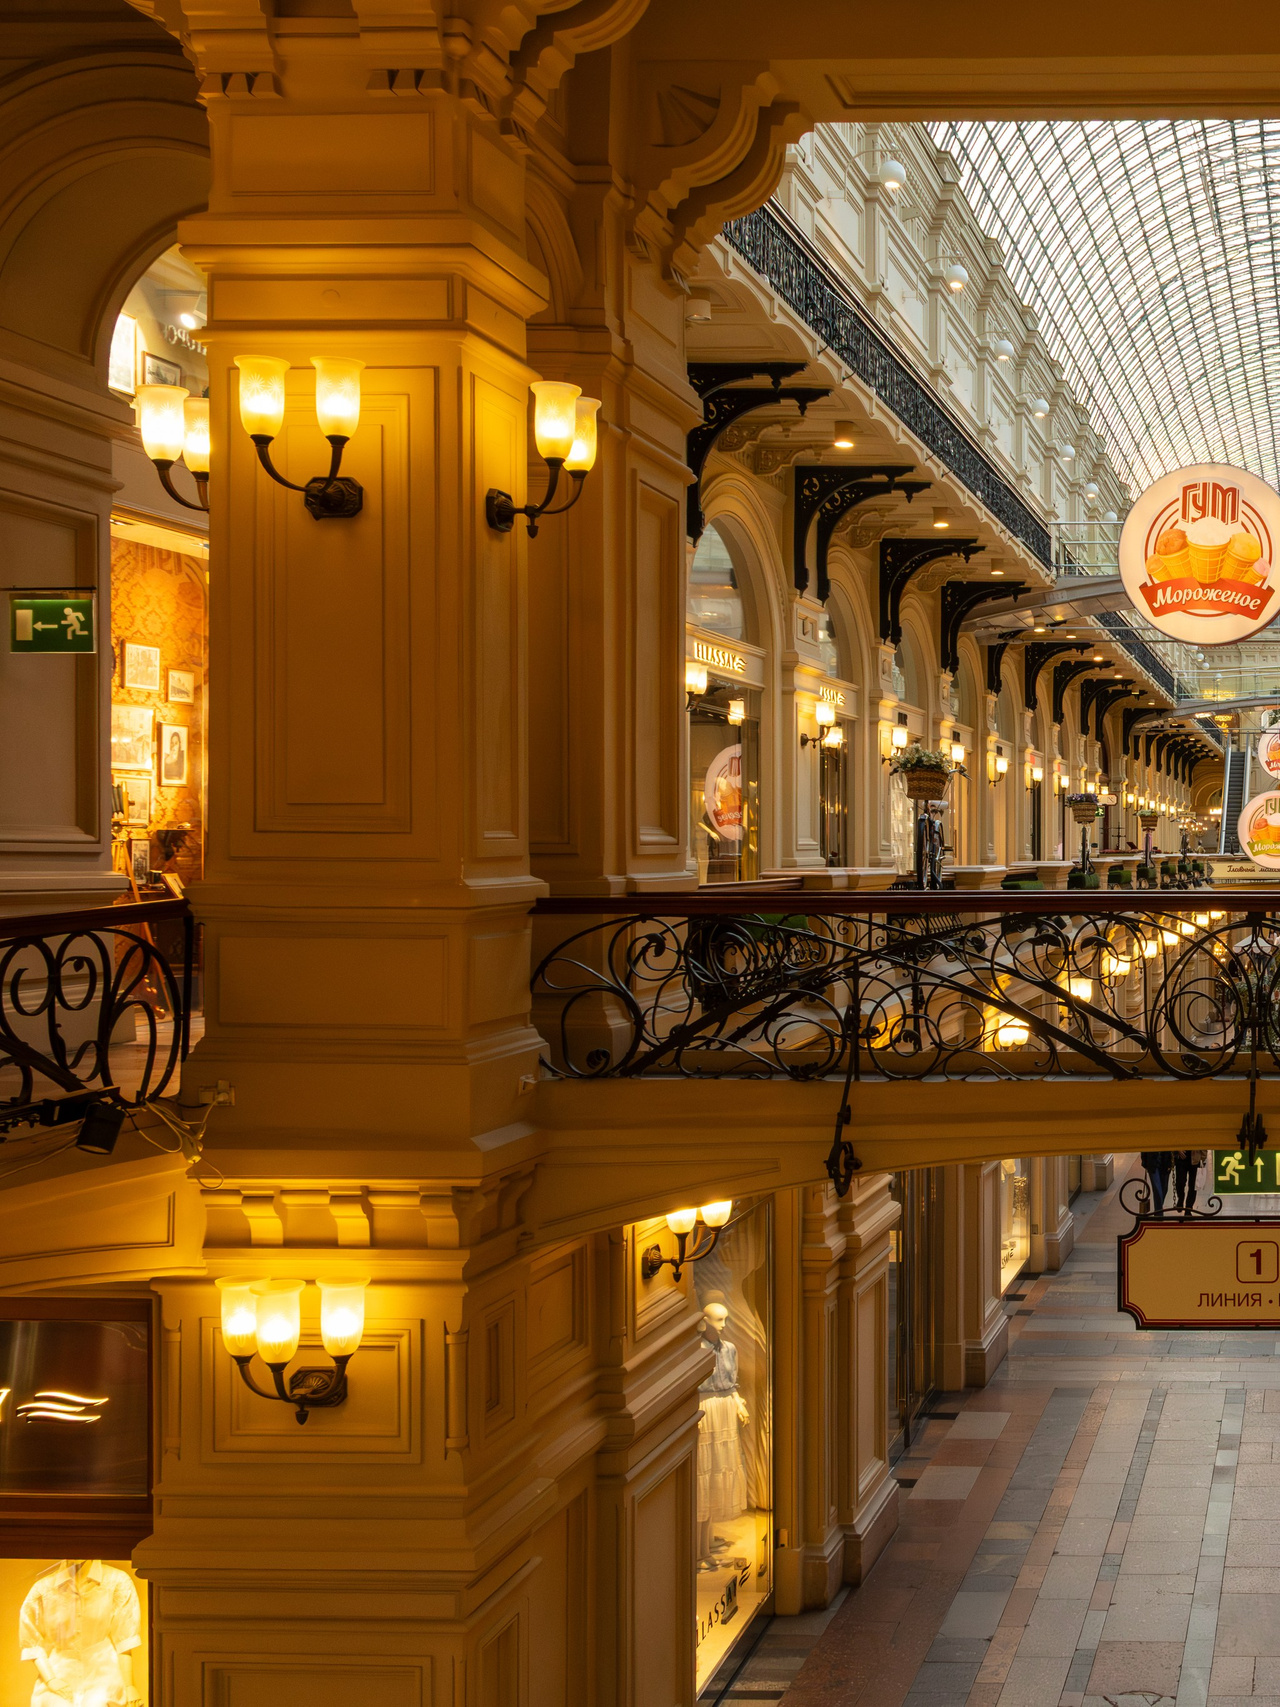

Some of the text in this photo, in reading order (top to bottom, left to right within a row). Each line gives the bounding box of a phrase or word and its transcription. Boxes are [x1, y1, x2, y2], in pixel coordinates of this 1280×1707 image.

[1181, 482, 1240, 525] ГУМ
[1152, 586, 1261, 611] Мороженое
[1227, 865, 1256, 873] Главный
[1249, 1248, 1262, 1276] 1
[1197, 1292, 1262, 1308] ЛИНИЯ
